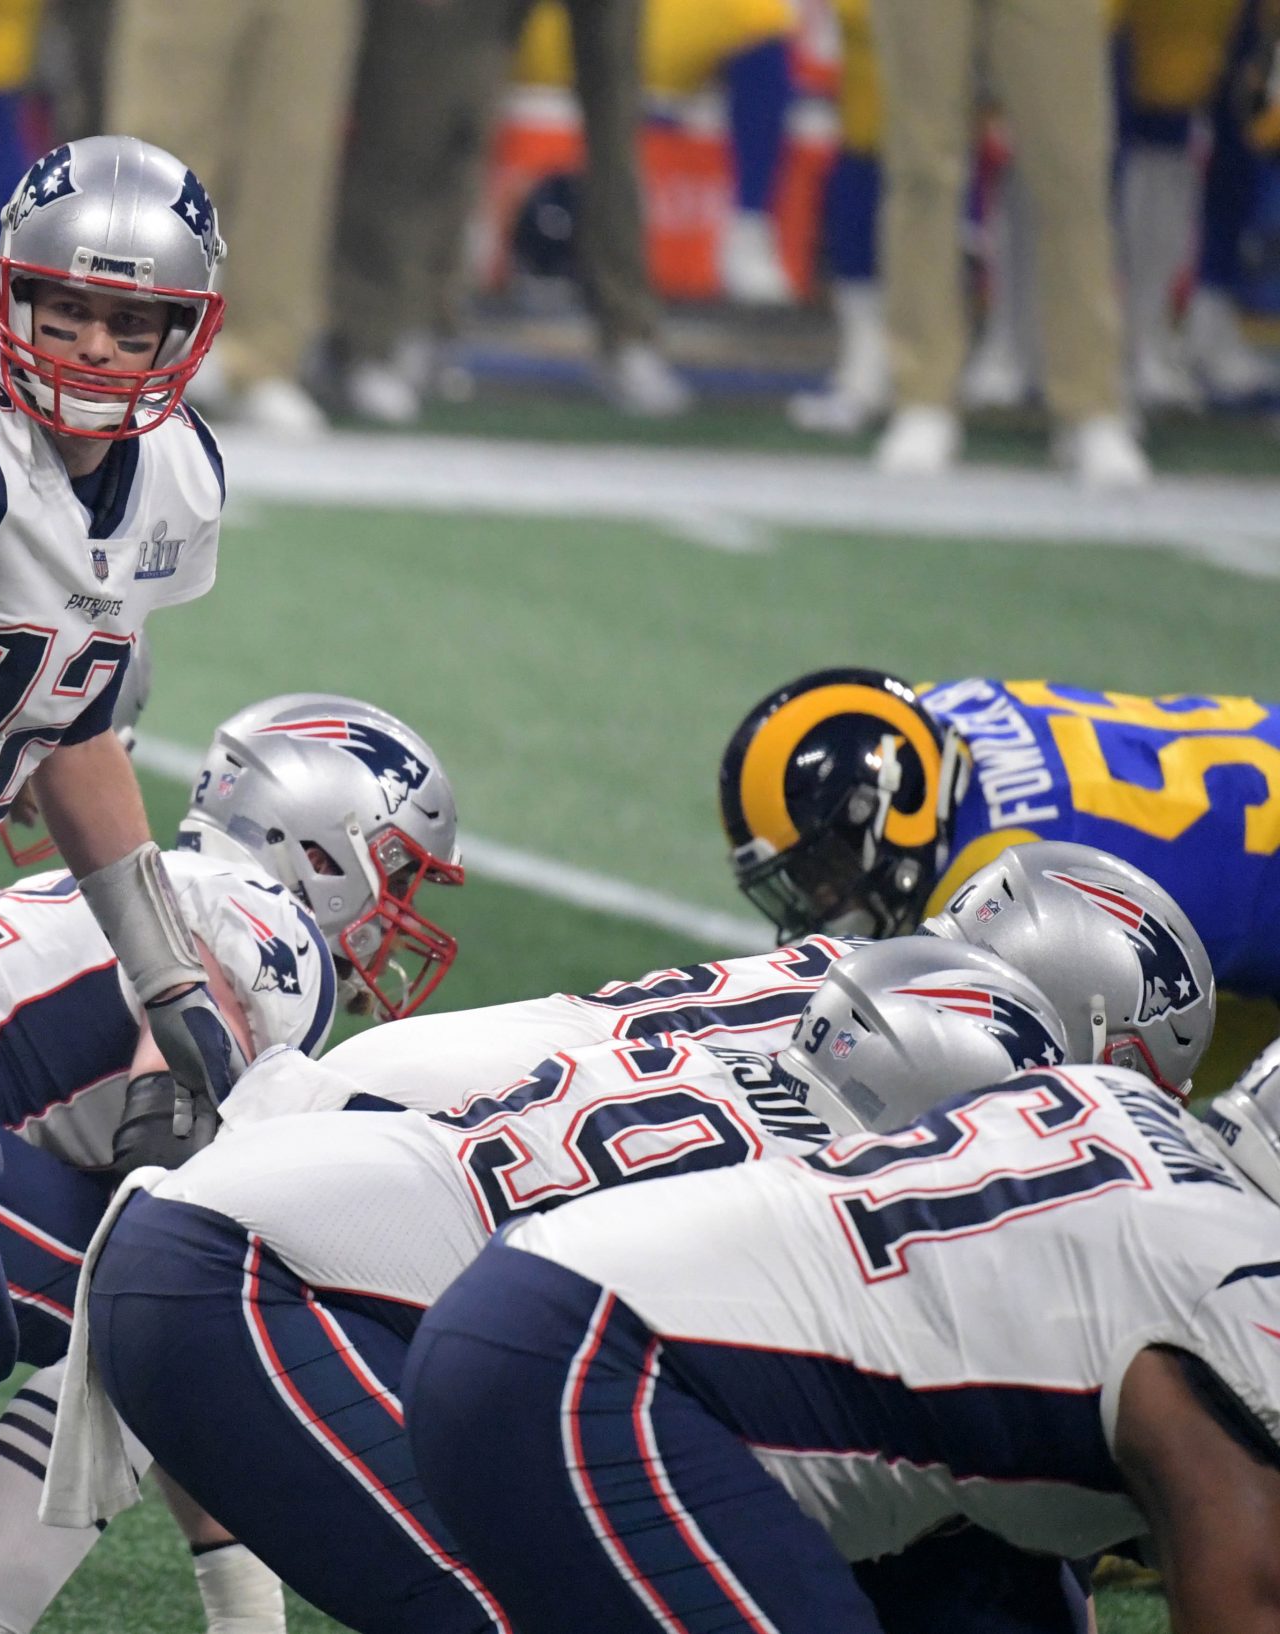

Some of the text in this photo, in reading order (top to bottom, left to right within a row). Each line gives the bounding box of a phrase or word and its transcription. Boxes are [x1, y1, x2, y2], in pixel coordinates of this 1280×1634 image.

[91, 255, 136, 278] PATRIOTS
[65, 593, 124, 617] PATRIOTS
[195, 769, 212, 804] 2
[420, 1031, 764, 1236] 69
[788, 1065, 1154, 1285] 61
